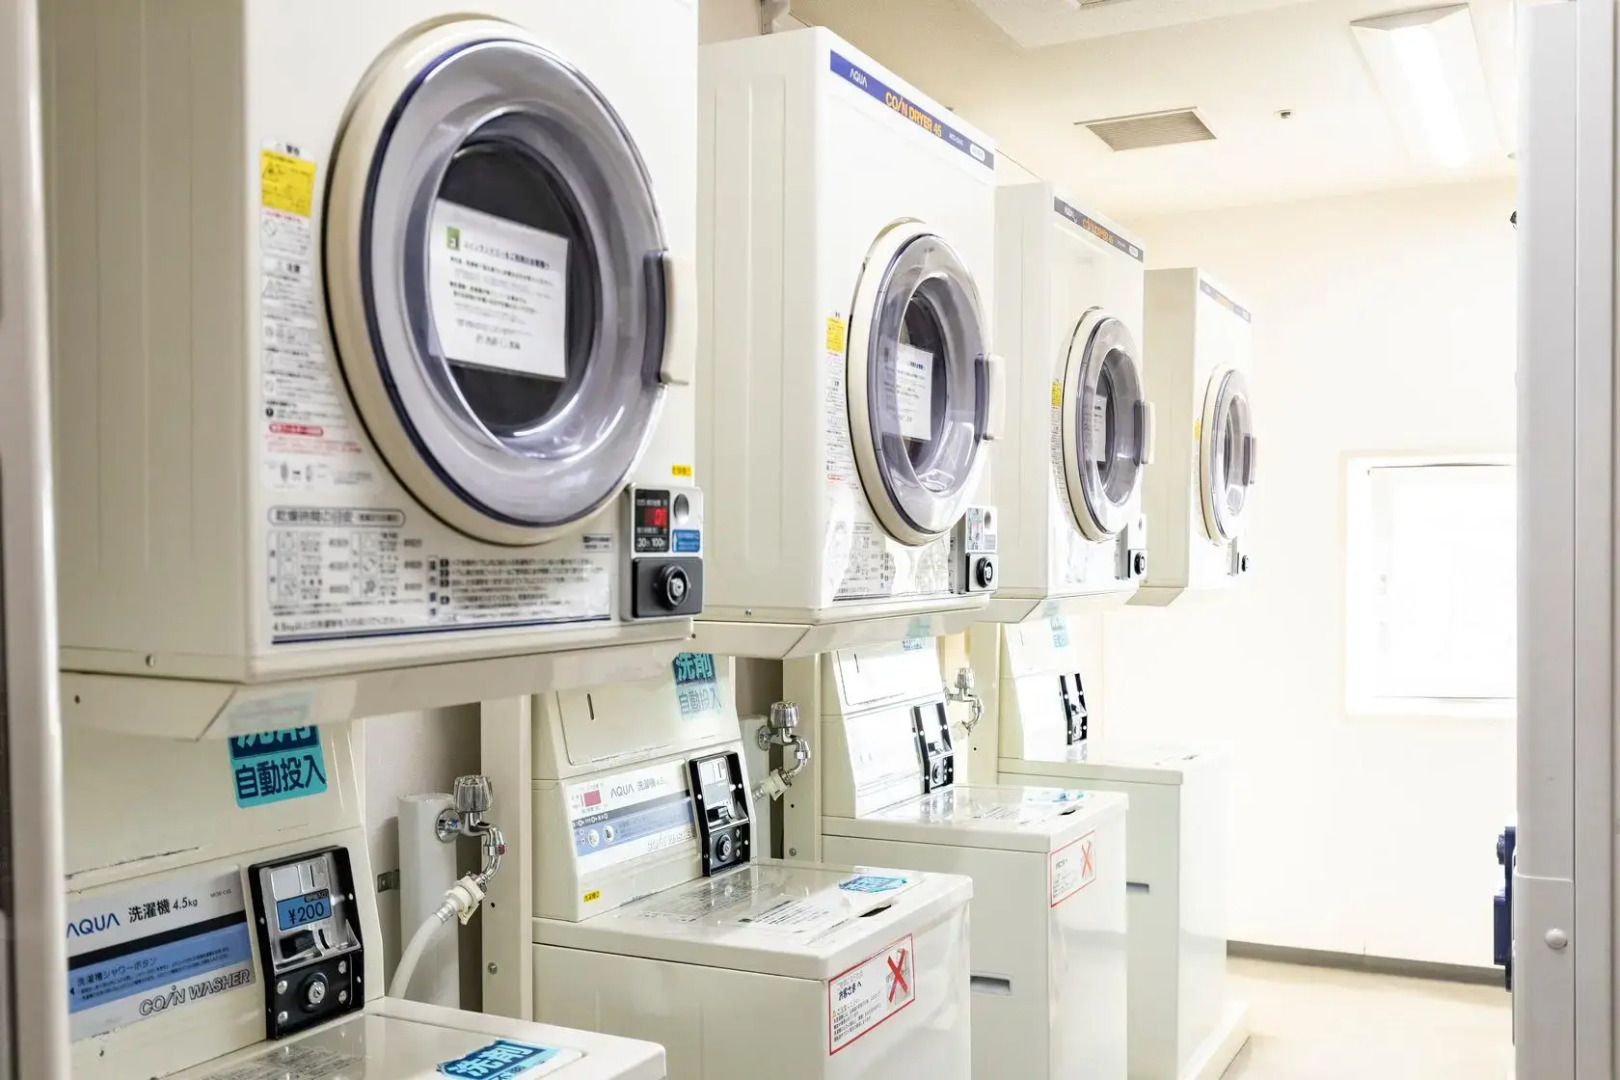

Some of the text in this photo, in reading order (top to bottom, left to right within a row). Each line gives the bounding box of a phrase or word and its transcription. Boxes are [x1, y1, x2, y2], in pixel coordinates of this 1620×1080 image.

[850, 68, 868, 88] AQUA
[885, 92, 908, 117] COIN
[908, 105, 933, 133] DRYER
[675, 652, 713, 681] 洗剤
[679, 686, 722, 715] 自動投入
[235, 755, 327, 800] 自動投入
[610, 782, 635, 799] AQUA
[66, 896, 198, 939] AQUA 洗濯機 4.5kg
[288, 901, 325, 925] ¥200
[138, 984, 187, 1017] COIN
[188, 967, 252, 1001] WASHER
[446, 1043, 534, 1077] 洗剤
